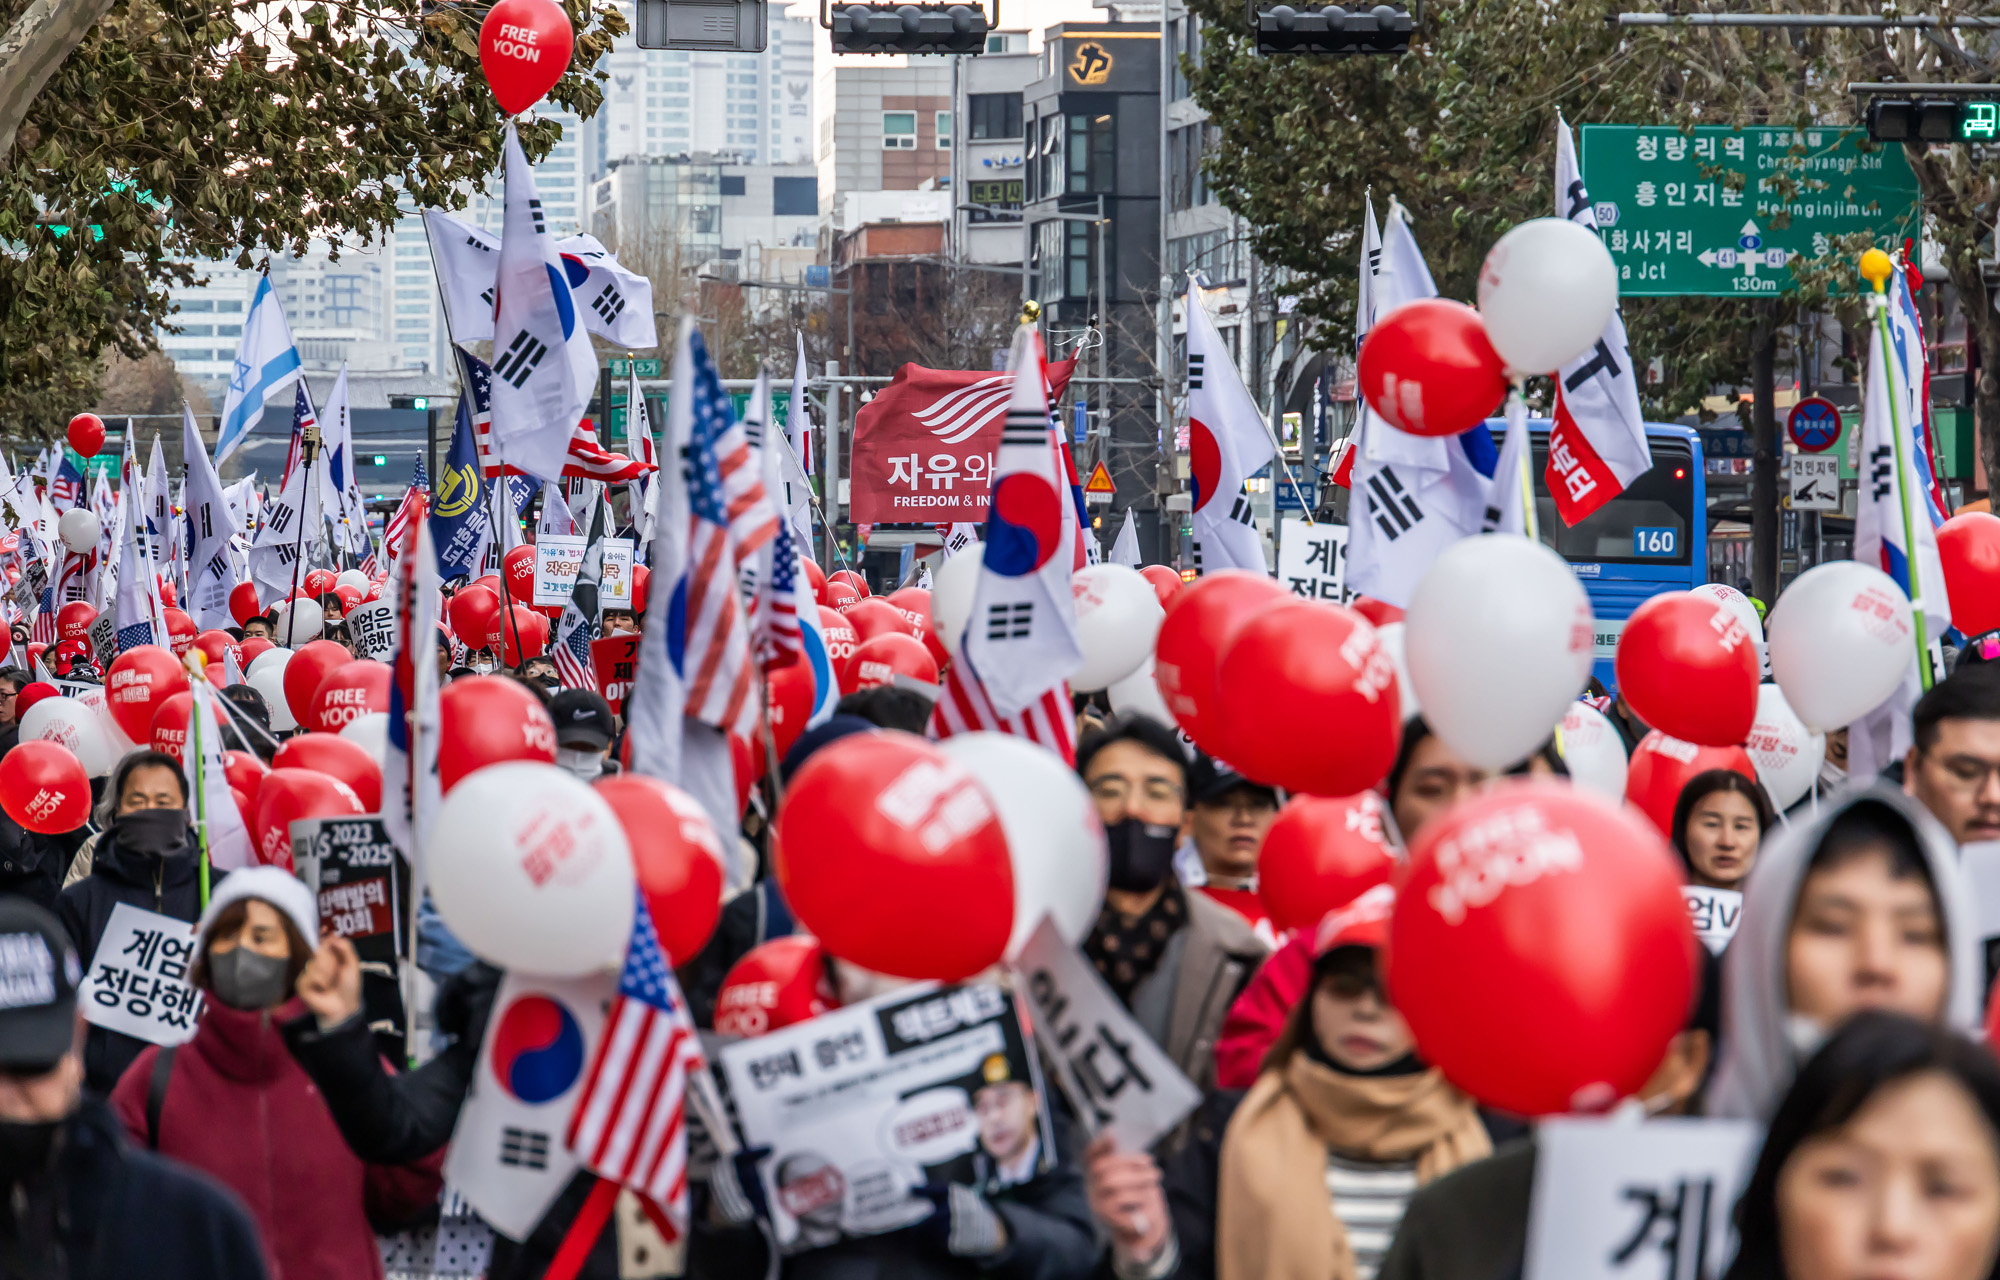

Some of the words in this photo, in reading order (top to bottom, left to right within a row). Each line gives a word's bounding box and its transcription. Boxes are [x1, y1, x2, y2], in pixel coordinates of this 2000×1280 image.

[500, 24, 539, 45] FREE
[493, 39, 541, 63] YOON
[1636, 136, 1745, 161] 청량리역
[1861, 154, 1882, 169] Stn
[1599, 208, 1613, 221] 50
[1746, 237, 1755, 247] 6
[1720, 252, 1734, 265] 41
[1769, 252, 1783, 265] 41
[1638, 261, 1666, 279] Jct
[1732, 277, 1776, 290] 130m
[887, 452, 997, 490] 자유와
[1793, 460, 1838, 476] 견인지역
[894, 495, 959, 507] FREEDOM
[963, 495, 973, 507] &
[977, 495, 993, 507] IN
[1638, 531, 1674, 552] 160
[512, 556, 534, 572] FREE
[1305, 539, 1347, 576] 계
[513, 564, 535, 581] YOO
[348, 596, 361, 604] FREE
[838, 596, 856, 605] FREE
[65, 622, 83, 630] FREE
[352, 607, 394, 637] 계엄은
[65, 628, 87, 637] YOON
[823, 628, 853, 642] FREE
[325, 688, 366, 707] FREE
[319, 706, 373, 727] YOON
[156, 728, 184, 743] FREE
[25, 788, 51, 816] FREE
[30, 790, 66, 824] YOON
[332, 823, 373, 845] 2023
[122, 928, 195, 980] 계엄
[93, 964, 200, 1030] 정당했
